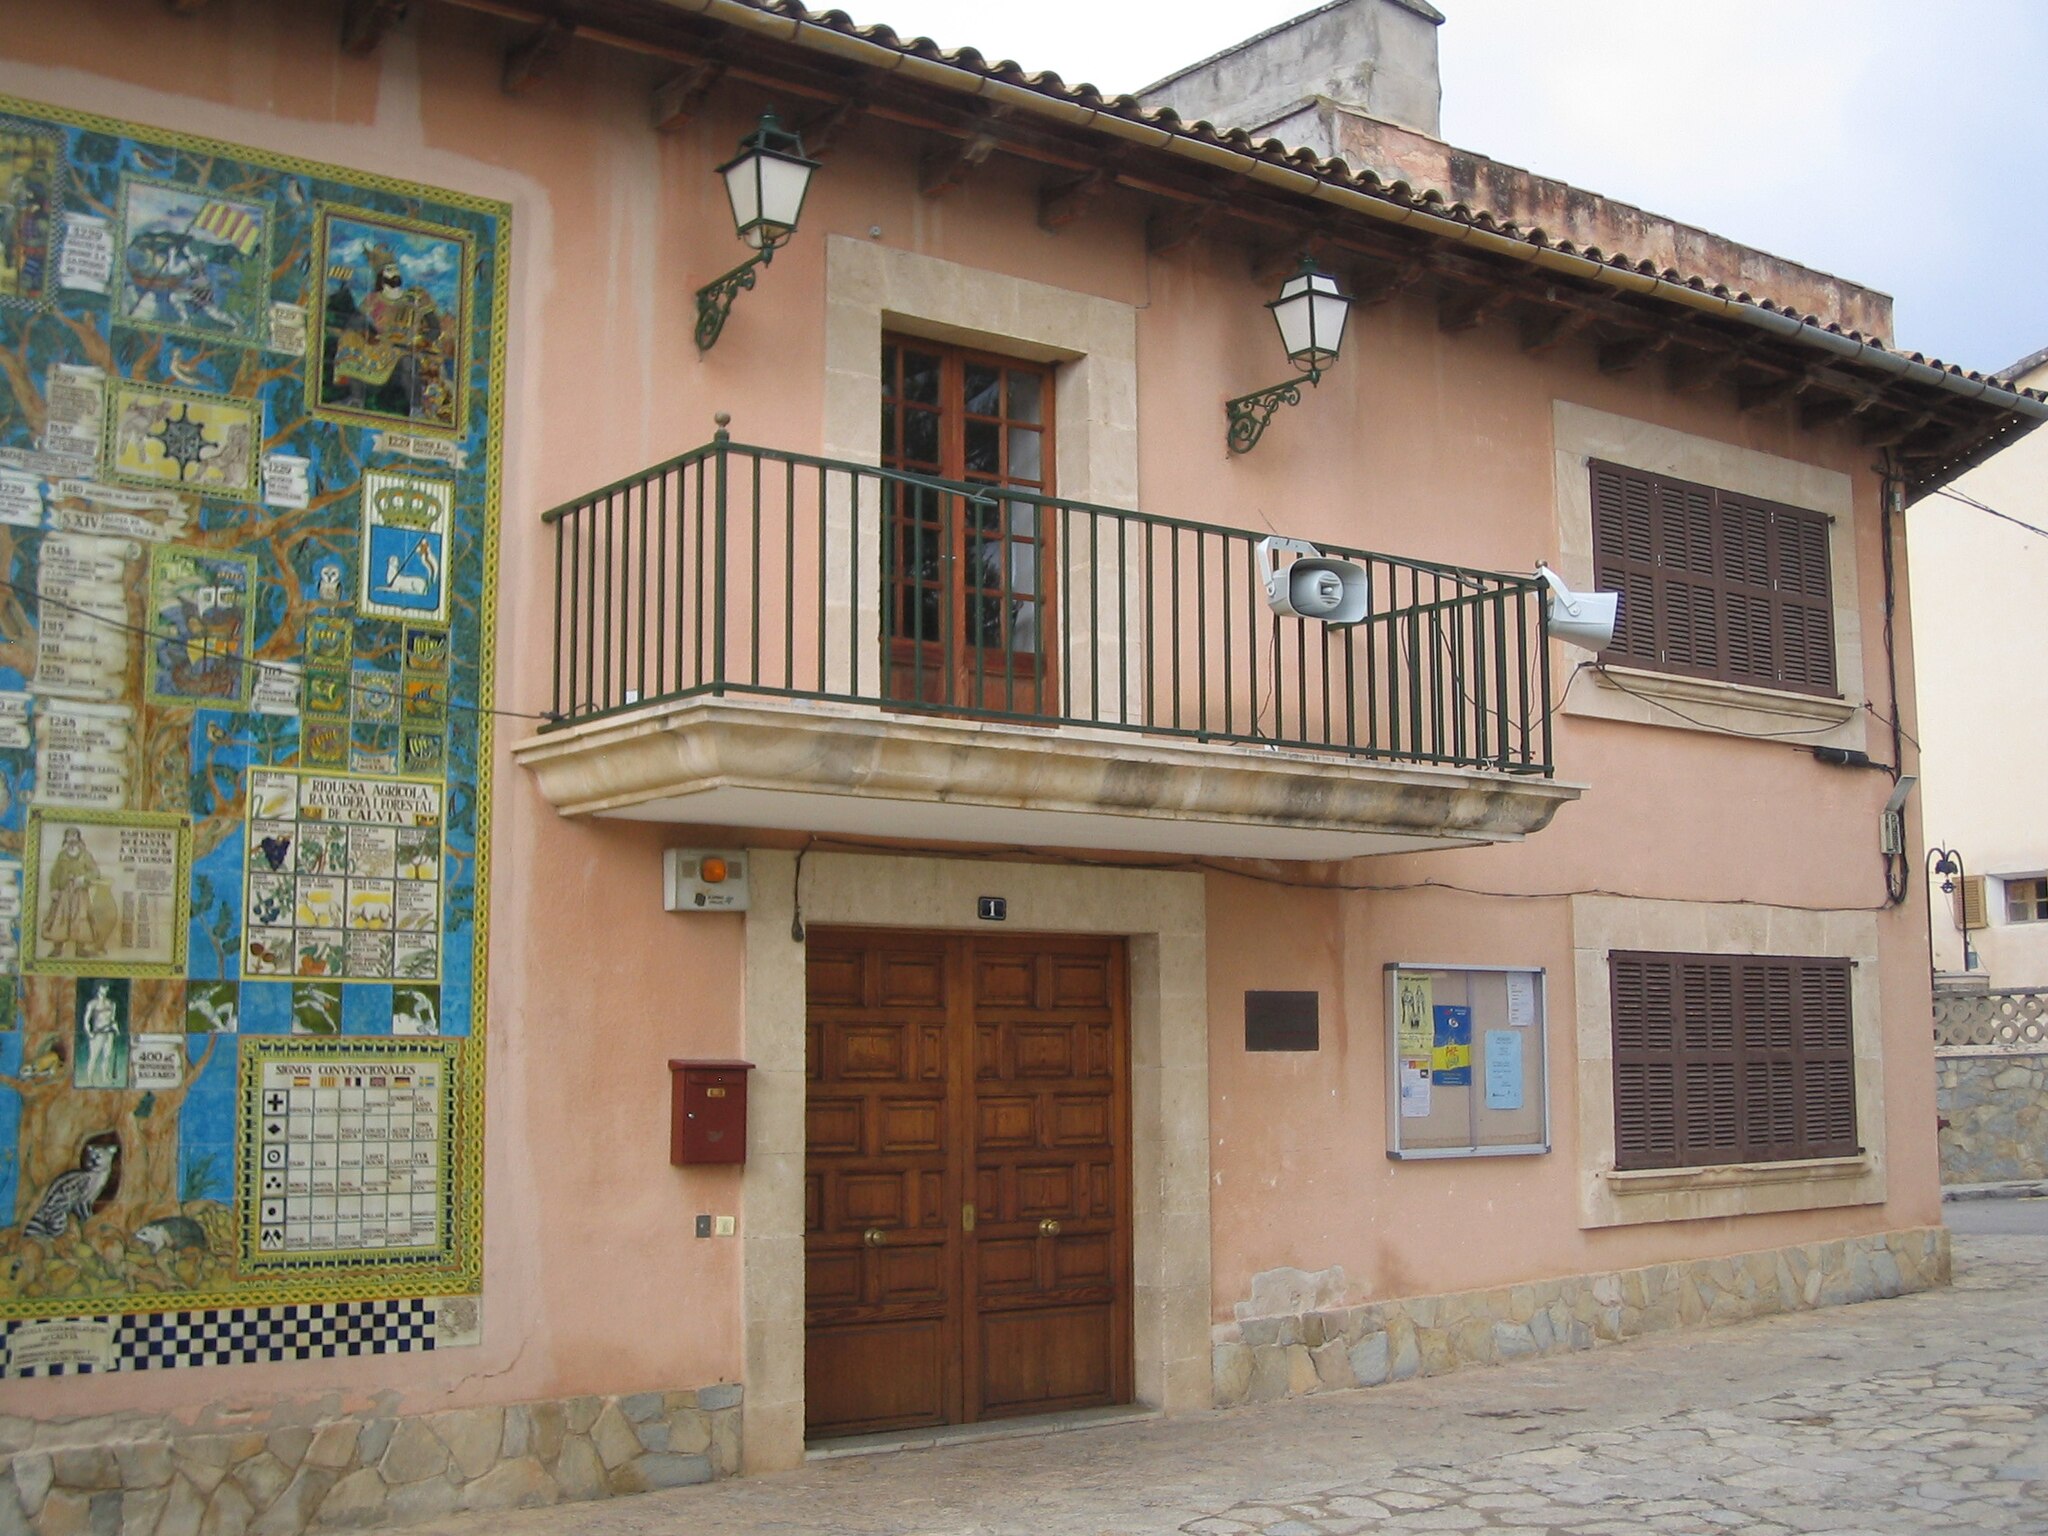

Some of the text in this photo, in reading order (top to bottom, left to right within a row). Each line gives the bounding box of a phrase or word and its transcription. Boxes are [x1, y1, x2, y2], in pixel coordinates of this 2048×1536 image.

[312, 779, 366, 796] RIQUESA
[308, 793, 370, 809] RAMADERA
[381, 799, 434, 813] FORESTAL
[328, 808, 340, 819] DE
[989, 901, 996, 916] 1
[275, 1064, 417, 1076] SIGNOS CONVENCIONALES
